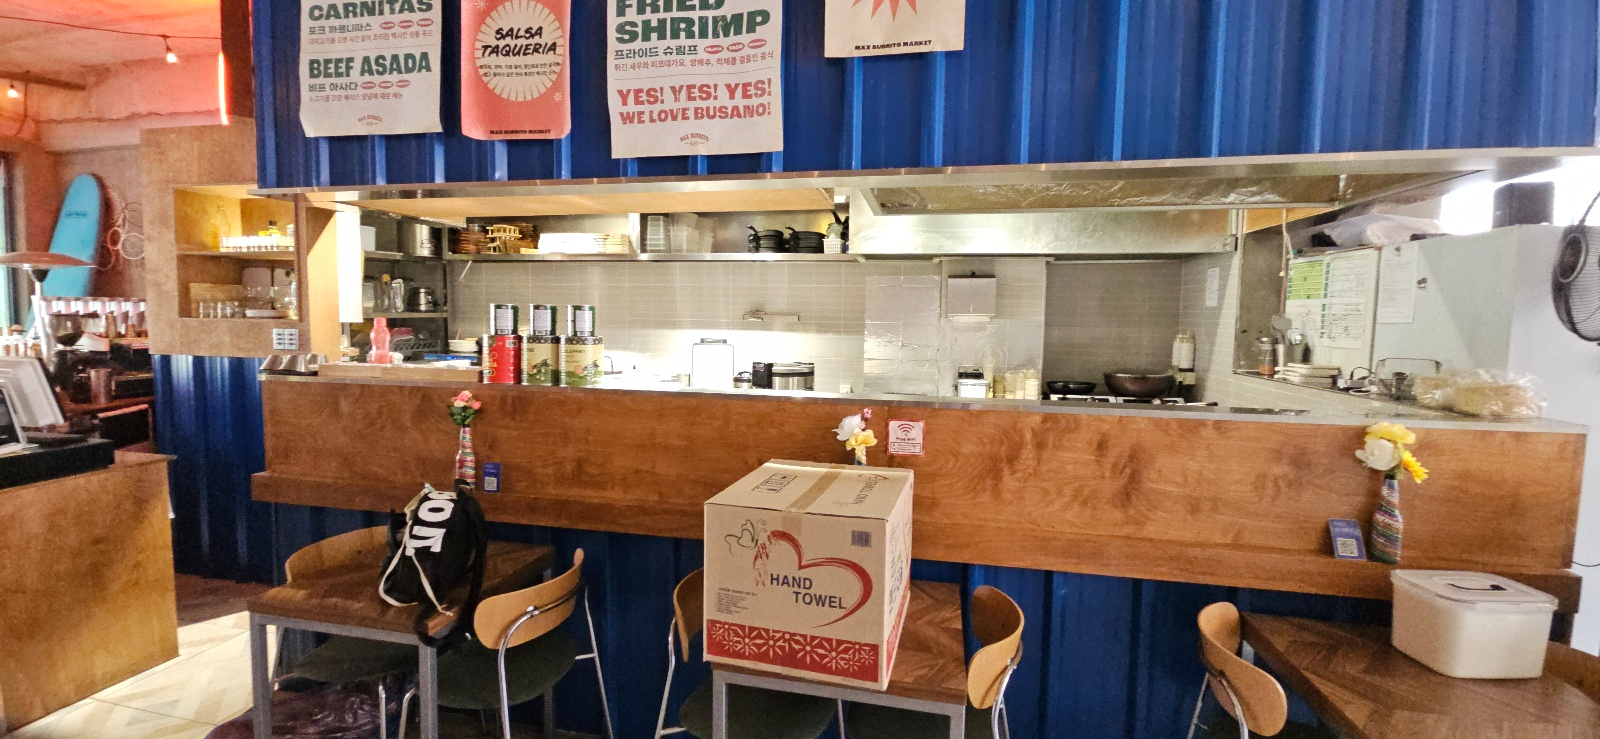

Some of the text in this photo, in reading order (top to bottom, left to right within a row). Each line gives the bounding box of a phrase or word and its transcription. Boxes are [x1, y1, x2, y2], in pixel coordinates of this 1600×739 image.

[308, 0, 434, 21] CARNITAS
[308, 26, 326, 35] 포크
[495, 26, 543, 41] SALSA
[615, 9, 771, 44] SHRIMP
[481, 42, 557, 57] TAQUERIA
[613, 44, 698, 60] 프라이드 슈림프
[308, 52, 432, 79] BEEF ASADA
[614, 63, 628, 72] 튀긴
[630, 60, 649, 70] 새우와
[308, 83, 326, 92] 비프
[329, 81, 358, 92] 아사다
[617, 78, 772, 106] YES! YES! YES!
[618, 102, 772, 125] WE LOVE BUSANO!
[769, 572, 813, 590] HAND
[793, 591, 848, 610] TOWEL
